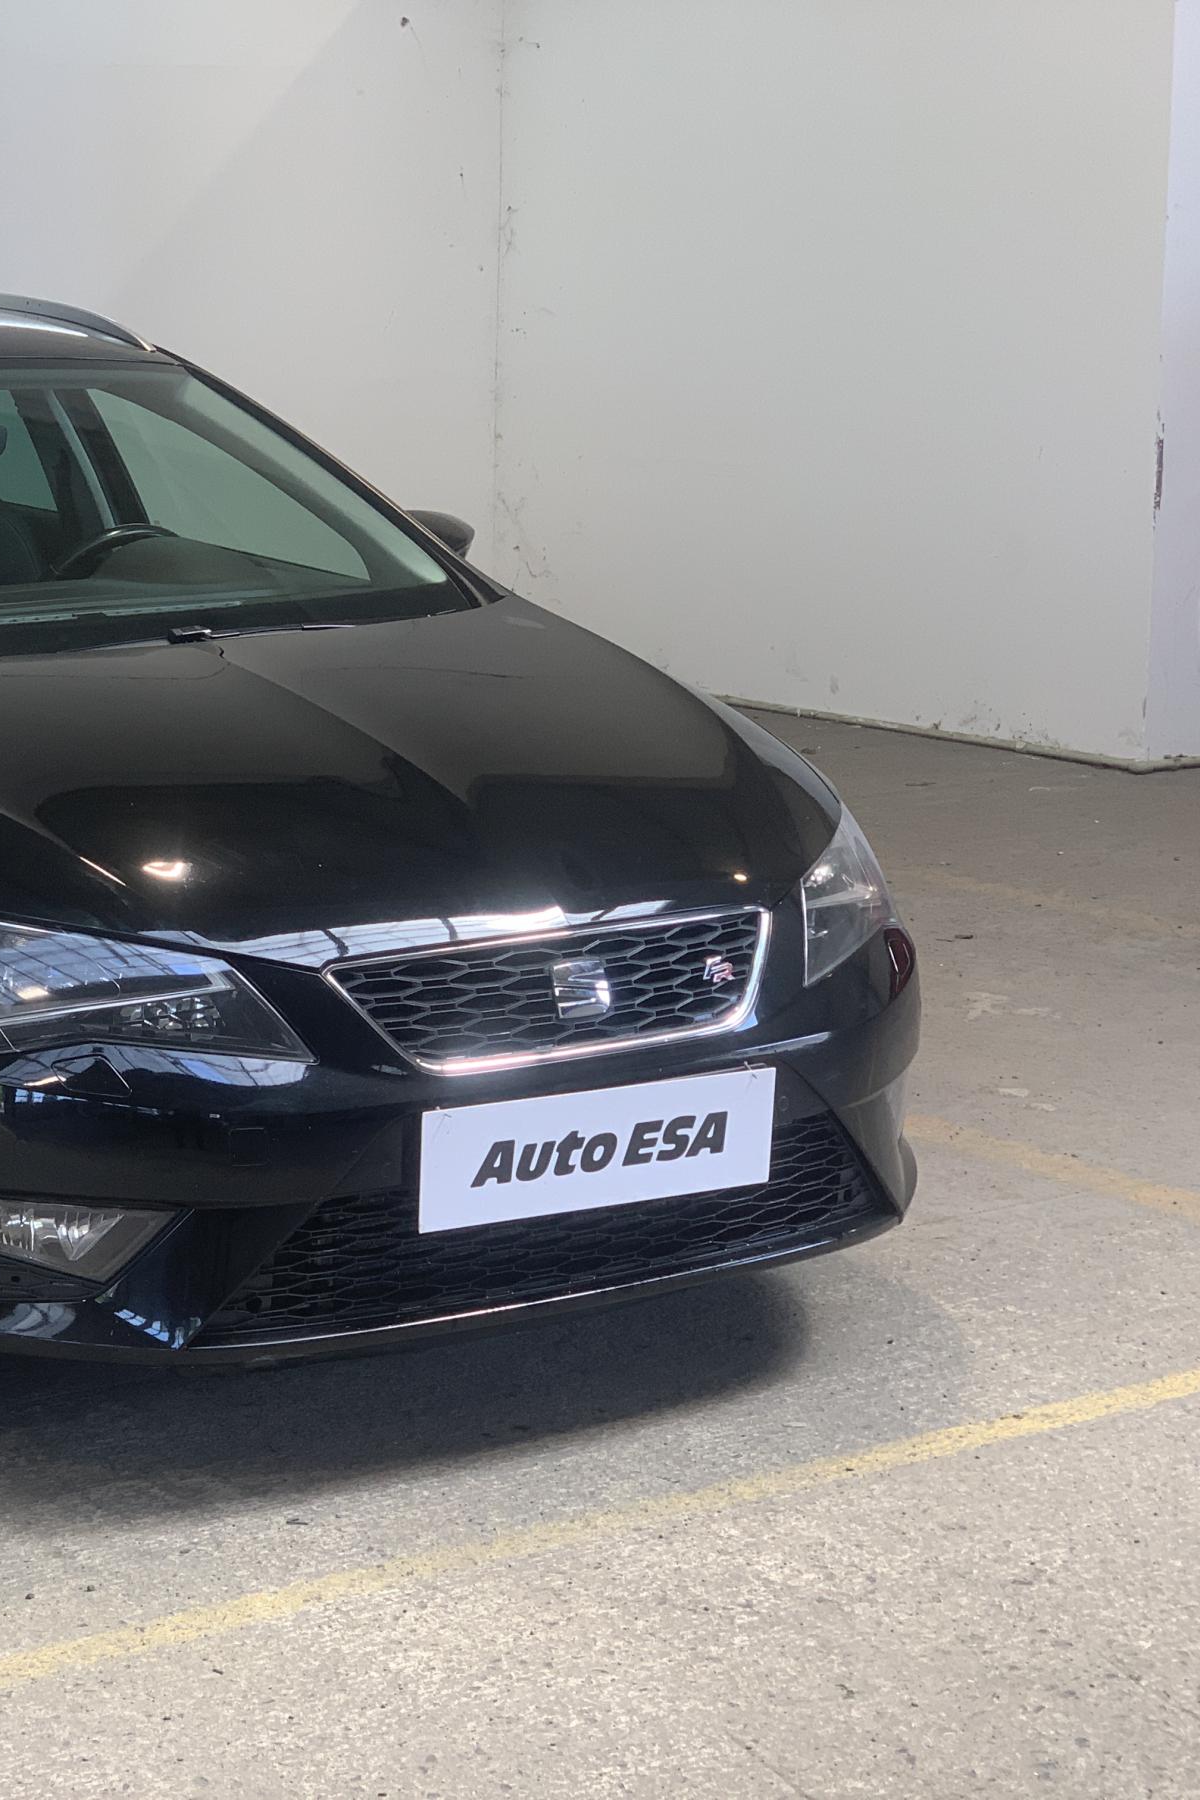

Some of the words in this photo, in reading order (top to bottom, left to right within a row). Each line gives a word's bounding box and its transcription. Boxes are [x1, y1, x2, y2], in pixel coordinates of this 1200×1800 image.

[703, 956, 735, 983] FR
[470, 1131, 618, 1188] Auto
[622, 1111, 728, 1167] ESA
